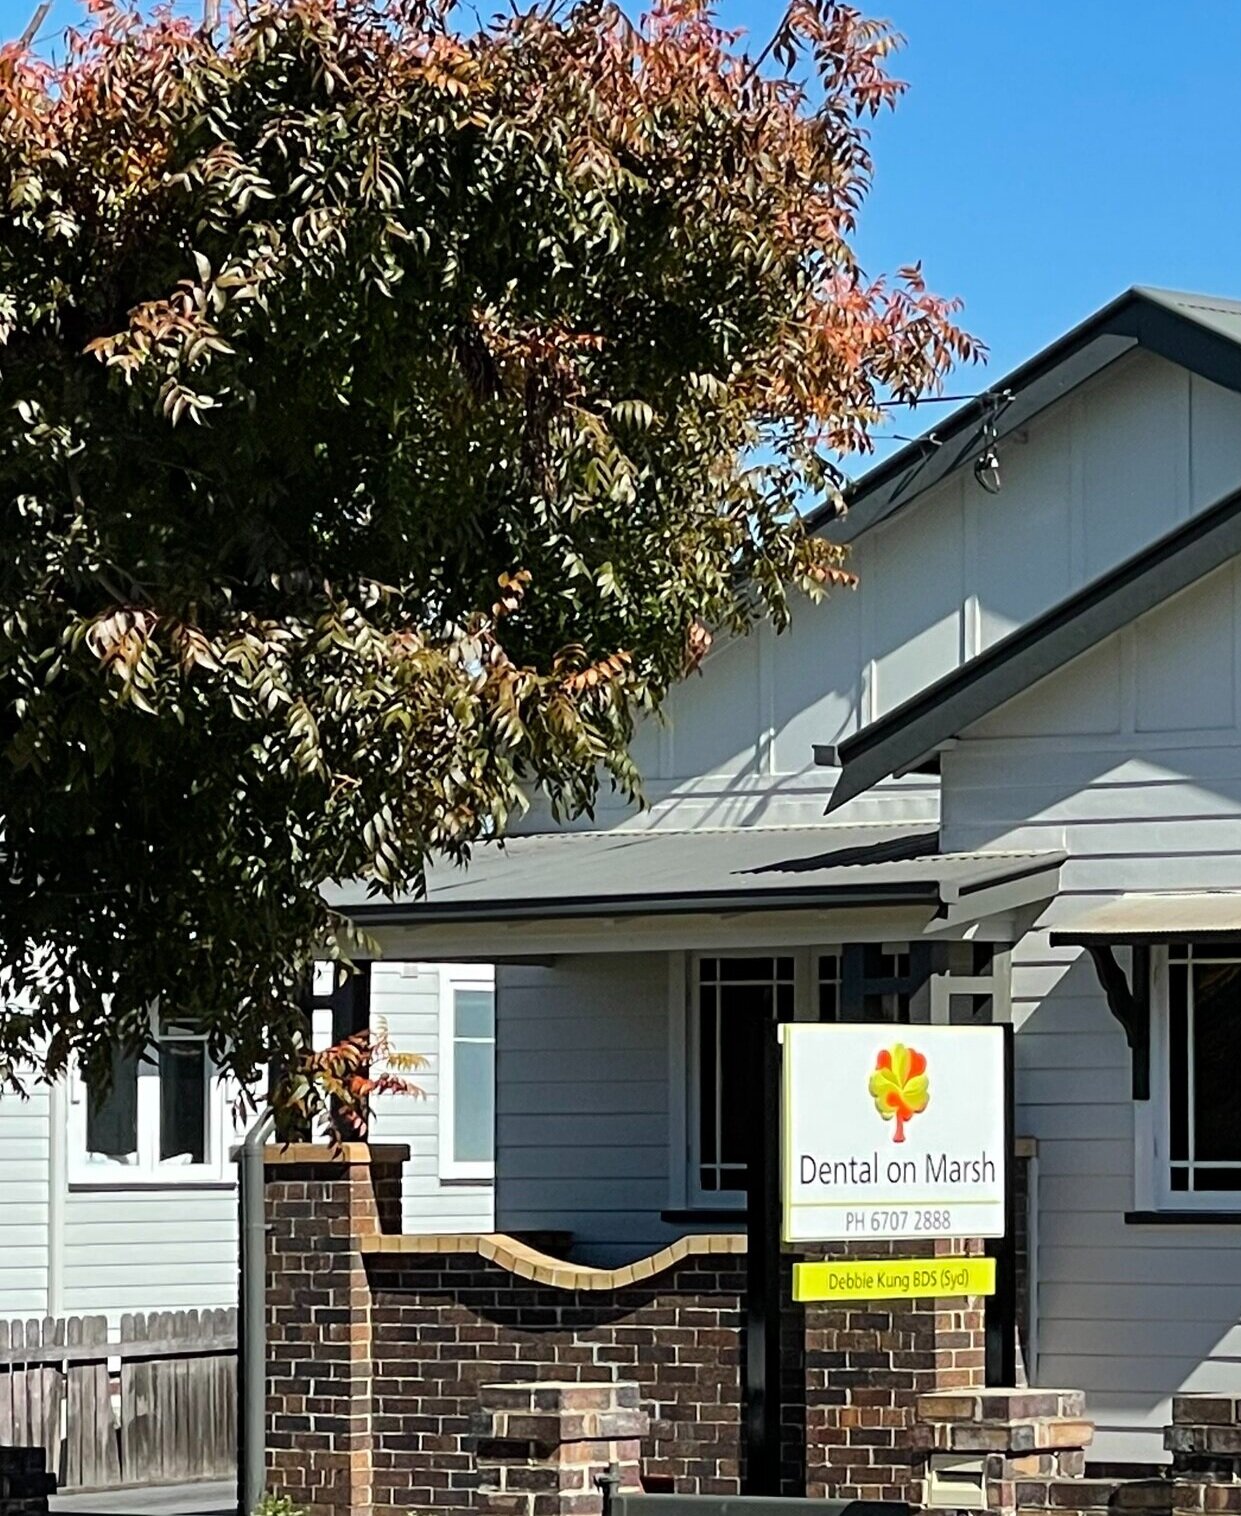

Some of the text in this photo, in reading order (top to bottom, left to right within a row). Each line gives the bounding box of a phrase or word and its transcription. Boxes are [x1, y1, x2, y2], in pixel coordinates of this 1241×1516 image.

[800, 1151, 996, 1184] Dental on Marsh
[845, 1210, 952, 1232] PH 6707 2888
[828, 1268, 970, 1292] Debbie Kung BDS (Syd)
